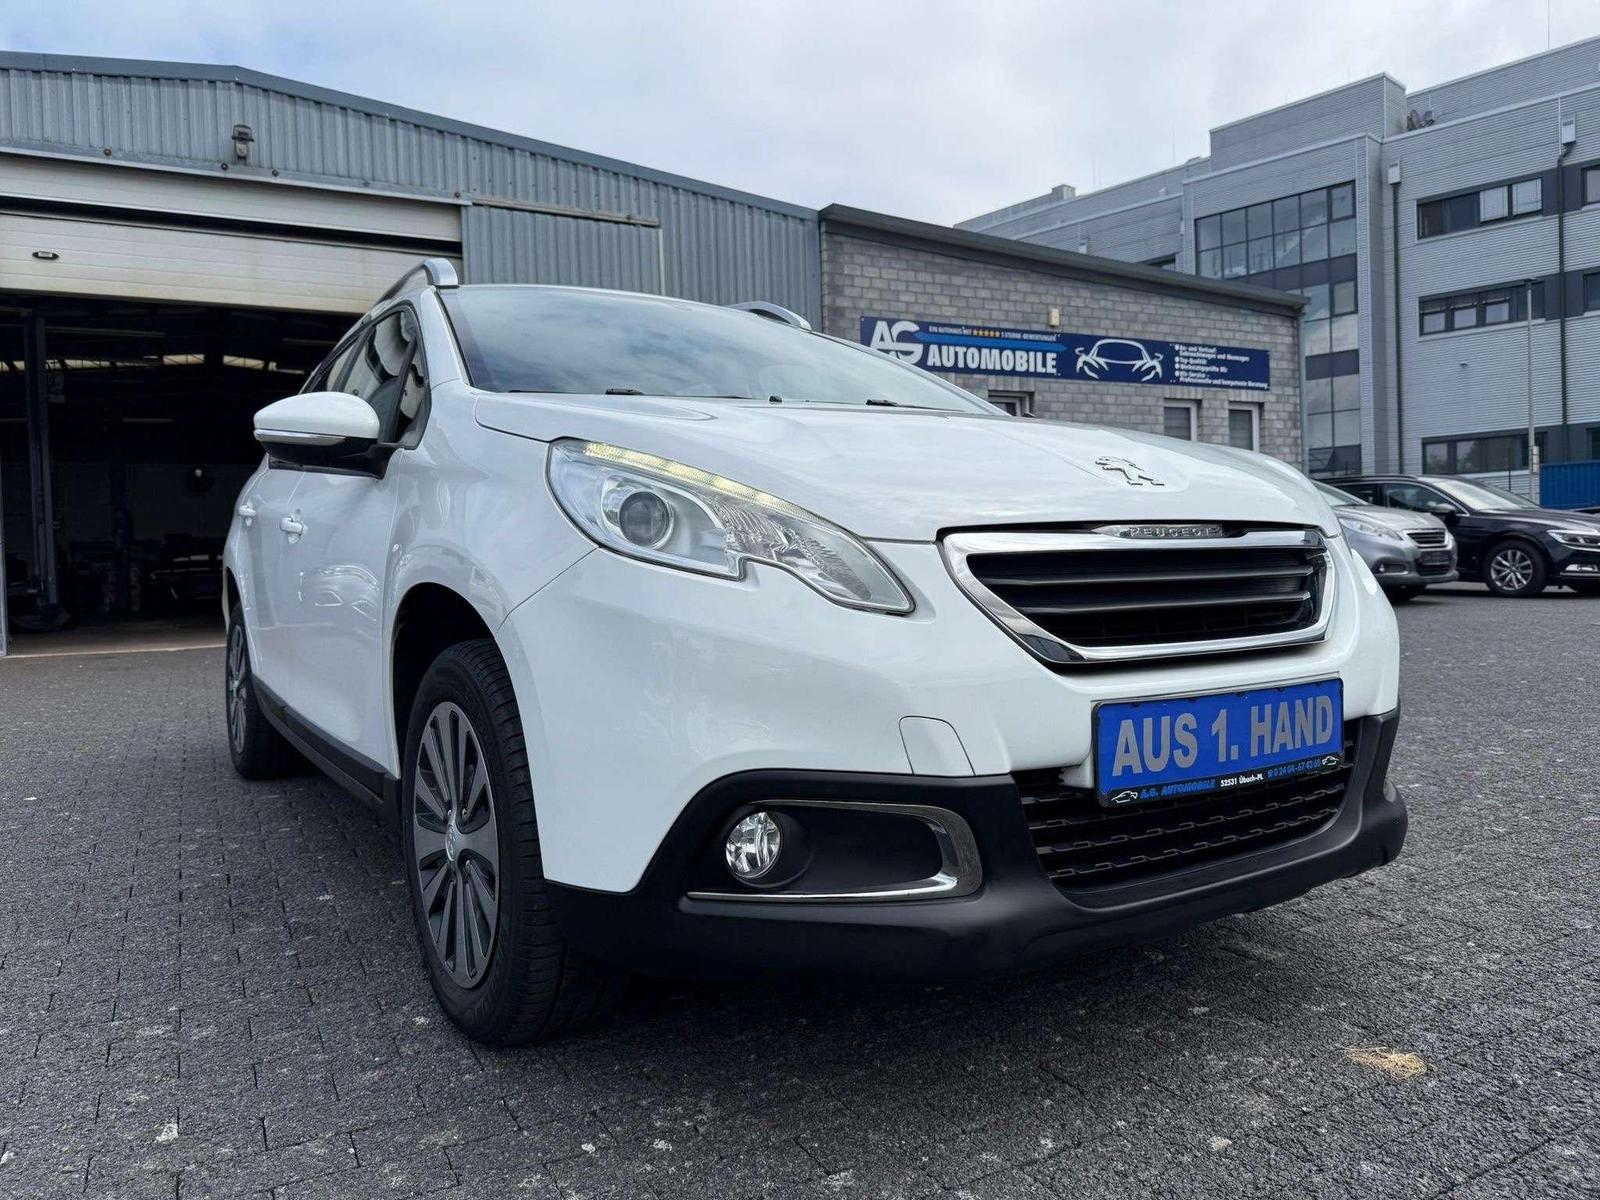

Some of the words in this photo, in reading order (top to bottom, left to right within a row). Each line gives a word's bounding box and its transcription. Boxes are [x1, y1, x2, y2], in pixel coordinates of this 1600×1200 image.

[870, 320, 924, 364] AG
[926, 344, 1057, 374] AUTOMOBILE
[1128, 526, 1221, 537] PEUGEOT
[1112, 713, 1199, 777] AUS
[1211, 708, 1239, 763] 1.
[1250, 695, 1333, 757] HAND
[1161, 779, 1216, 796] AUTOMOBILE
[1220, 779, 1238, 788] 52531
